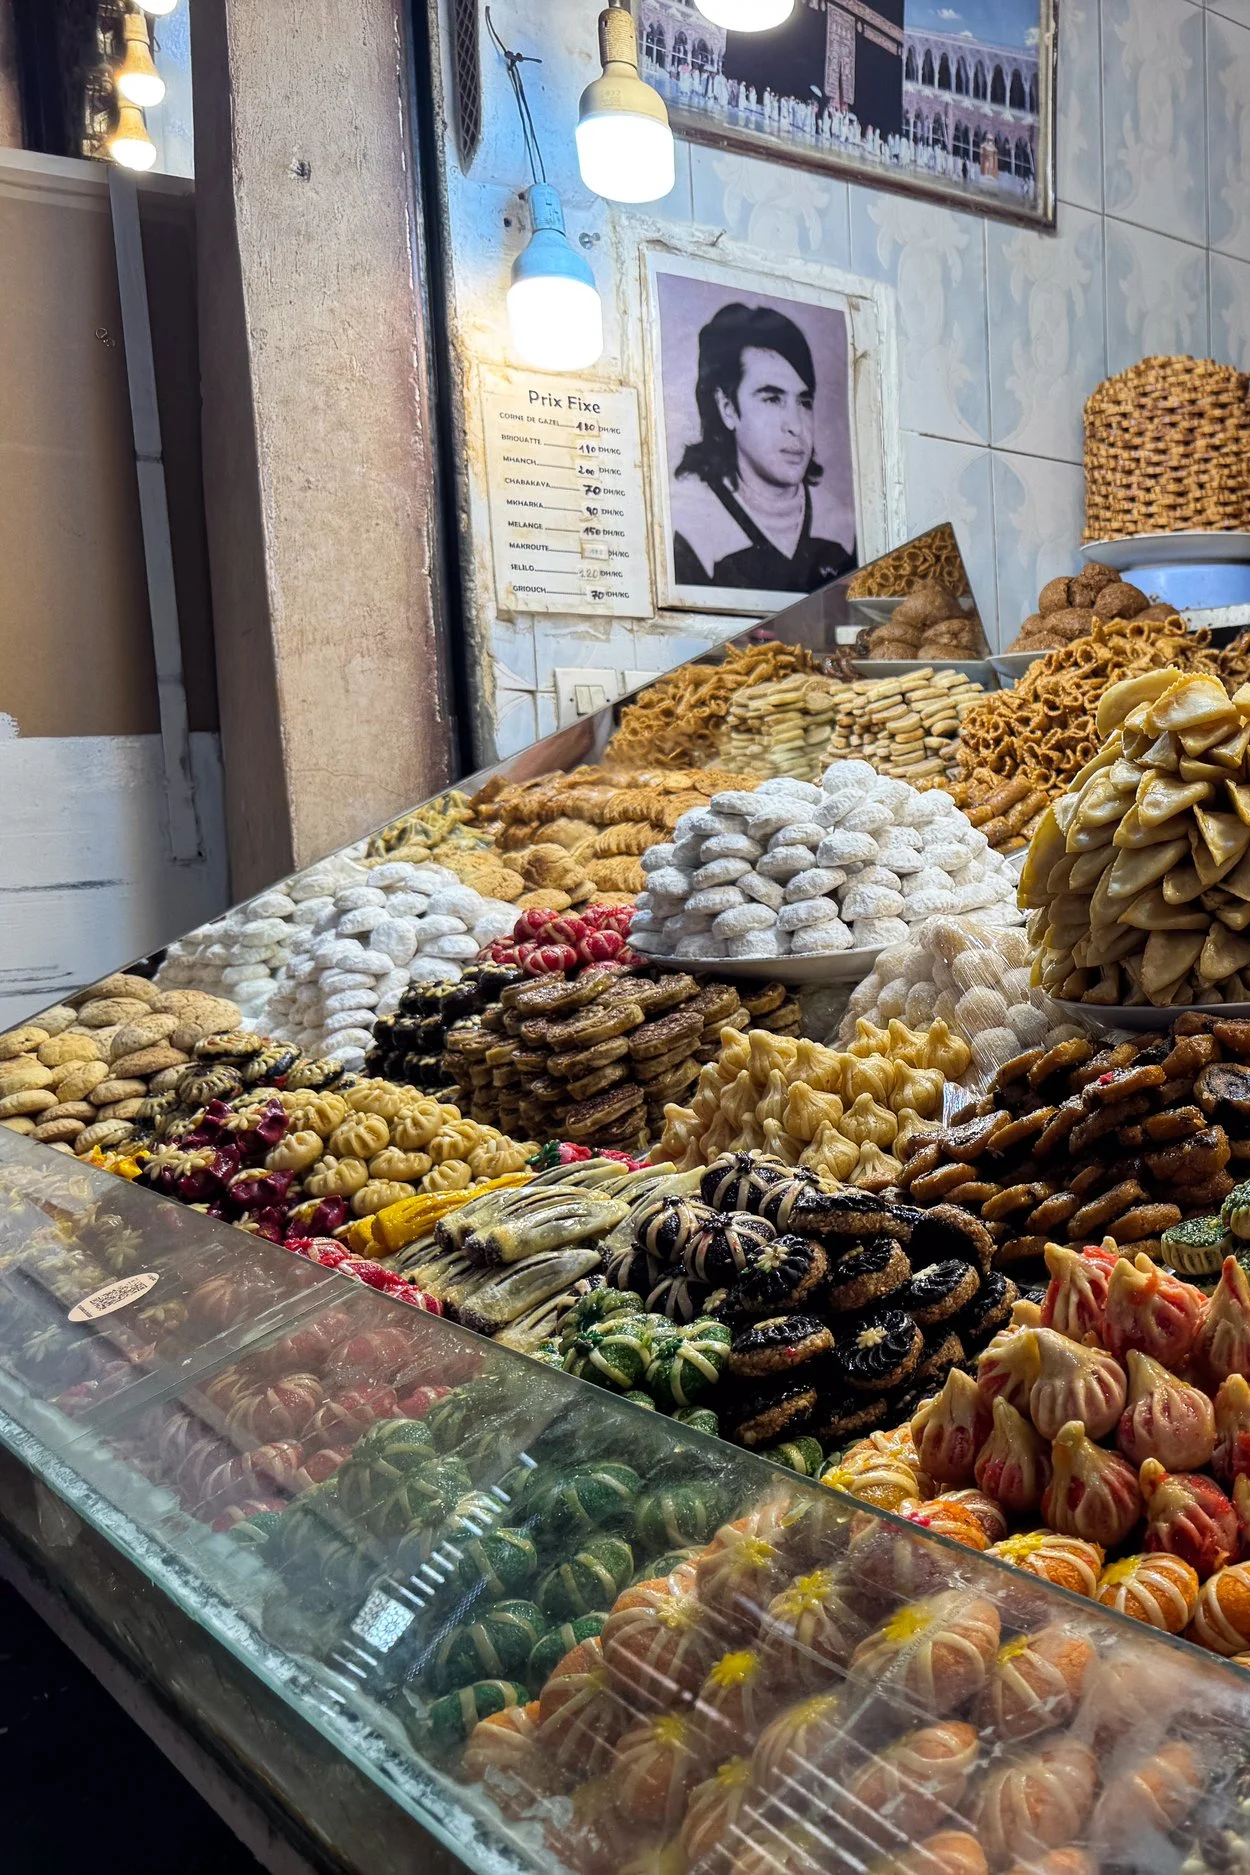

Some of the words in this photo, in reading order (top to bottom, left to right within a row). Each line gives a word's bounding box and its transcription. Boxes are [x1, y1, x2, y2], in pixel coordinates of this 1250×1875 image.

[528, 389, 562, 409] Prix
[567, 396, 600, 414] Fixe
[578, 465, 595, 476] 200
[583, 484, 601, 495] 70
[591, 590, 605, 600] 70
